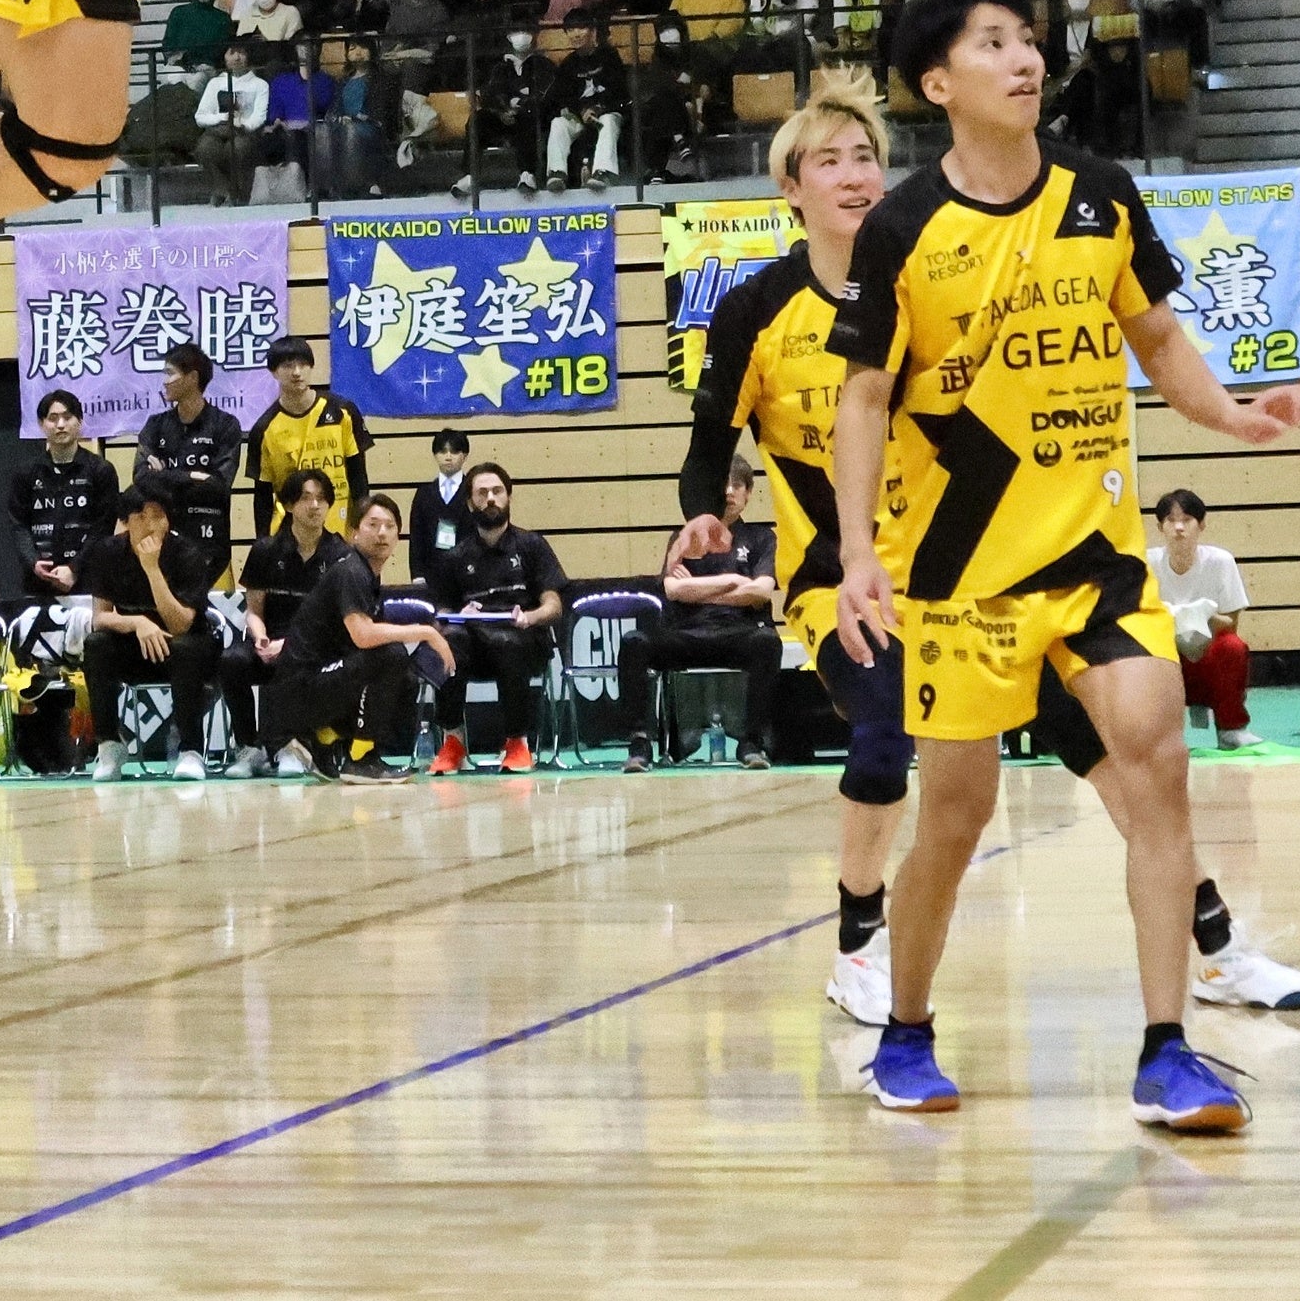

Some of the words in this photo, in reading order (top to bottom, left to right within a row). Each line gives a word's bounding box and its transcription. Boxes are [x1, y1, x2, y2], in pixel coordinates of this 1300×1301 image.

[1139, 188, 1213, 208] ELLOW
[1219, 182, 1295, 206] STARS
[332, 219, 442, 239] HOKKAIDO
[448, 217, 531, 236] YELLOW
[537, 213, 608, 233] STARS
[699, 217, 781, 233] HOKKAIDO
[54, 245, 260, 276] 小柄な選手の目標へ
[927, 253, 985, 283] RESORT
[1053, 275, 1106, 306] GEA
[27, 282, 279, 380] 藤巻睦
[337, 276, 608, 355] 伊庭笙弘
[1229, 329, 1300, 375] #2
[523, 355, 610, 398] #18
[78, 392, 151, 416] ujimaki
[1031, 401, 1124, 433] DONGU
[1102, 469, 1124, 507] 9
[200, 525, 214, 538] 16
[918, 682, 937, 721] 9
